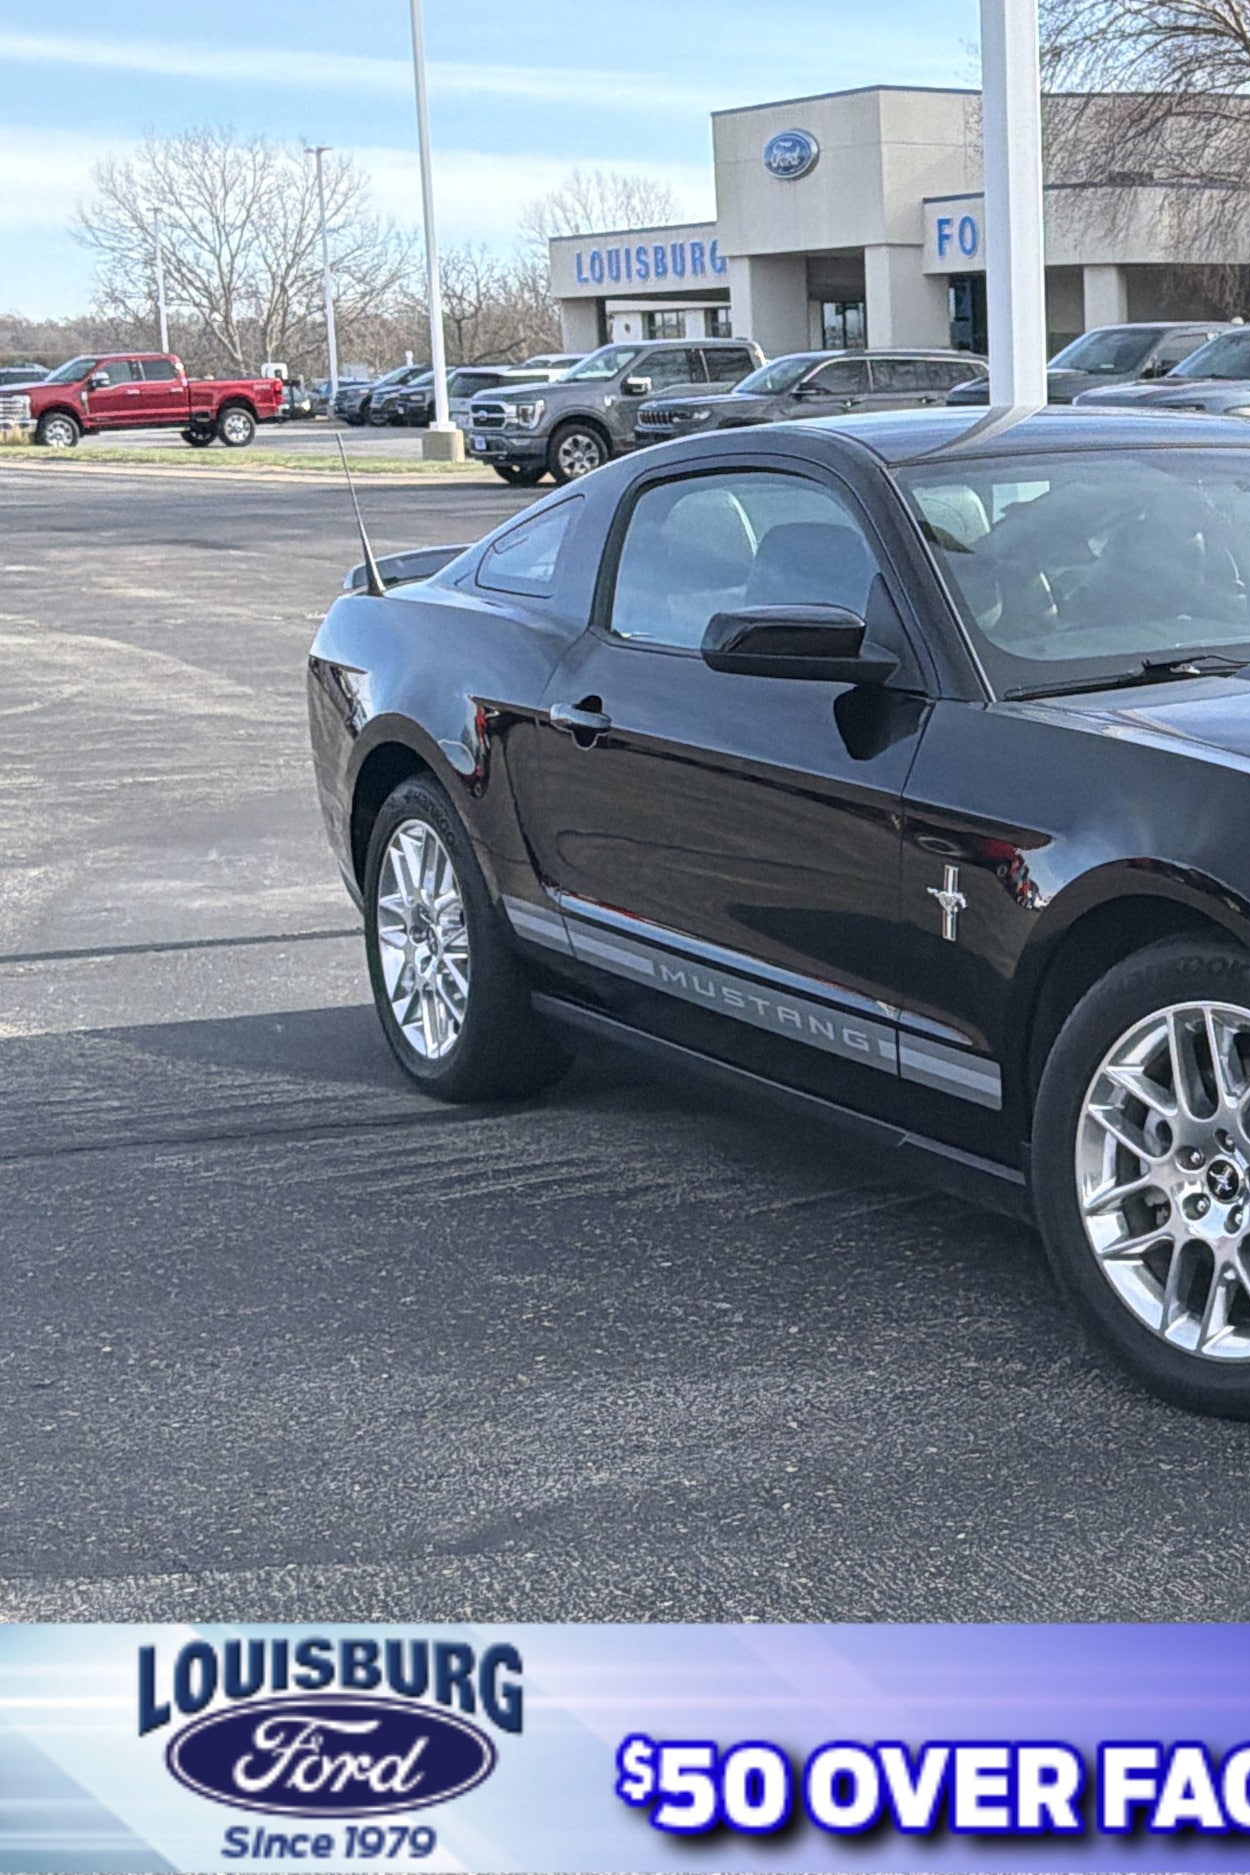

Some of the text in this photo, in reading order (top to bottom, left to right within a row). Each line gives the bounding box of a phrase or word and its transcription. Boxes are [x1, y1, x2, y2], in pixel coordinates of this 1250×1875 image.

[771, 141, 800, 168] Ford
[936, 215, 979, 258] FO
[576, 239, 727, 284] LOUISBURG
[660, 964, 870, 1052] MUSTANG
